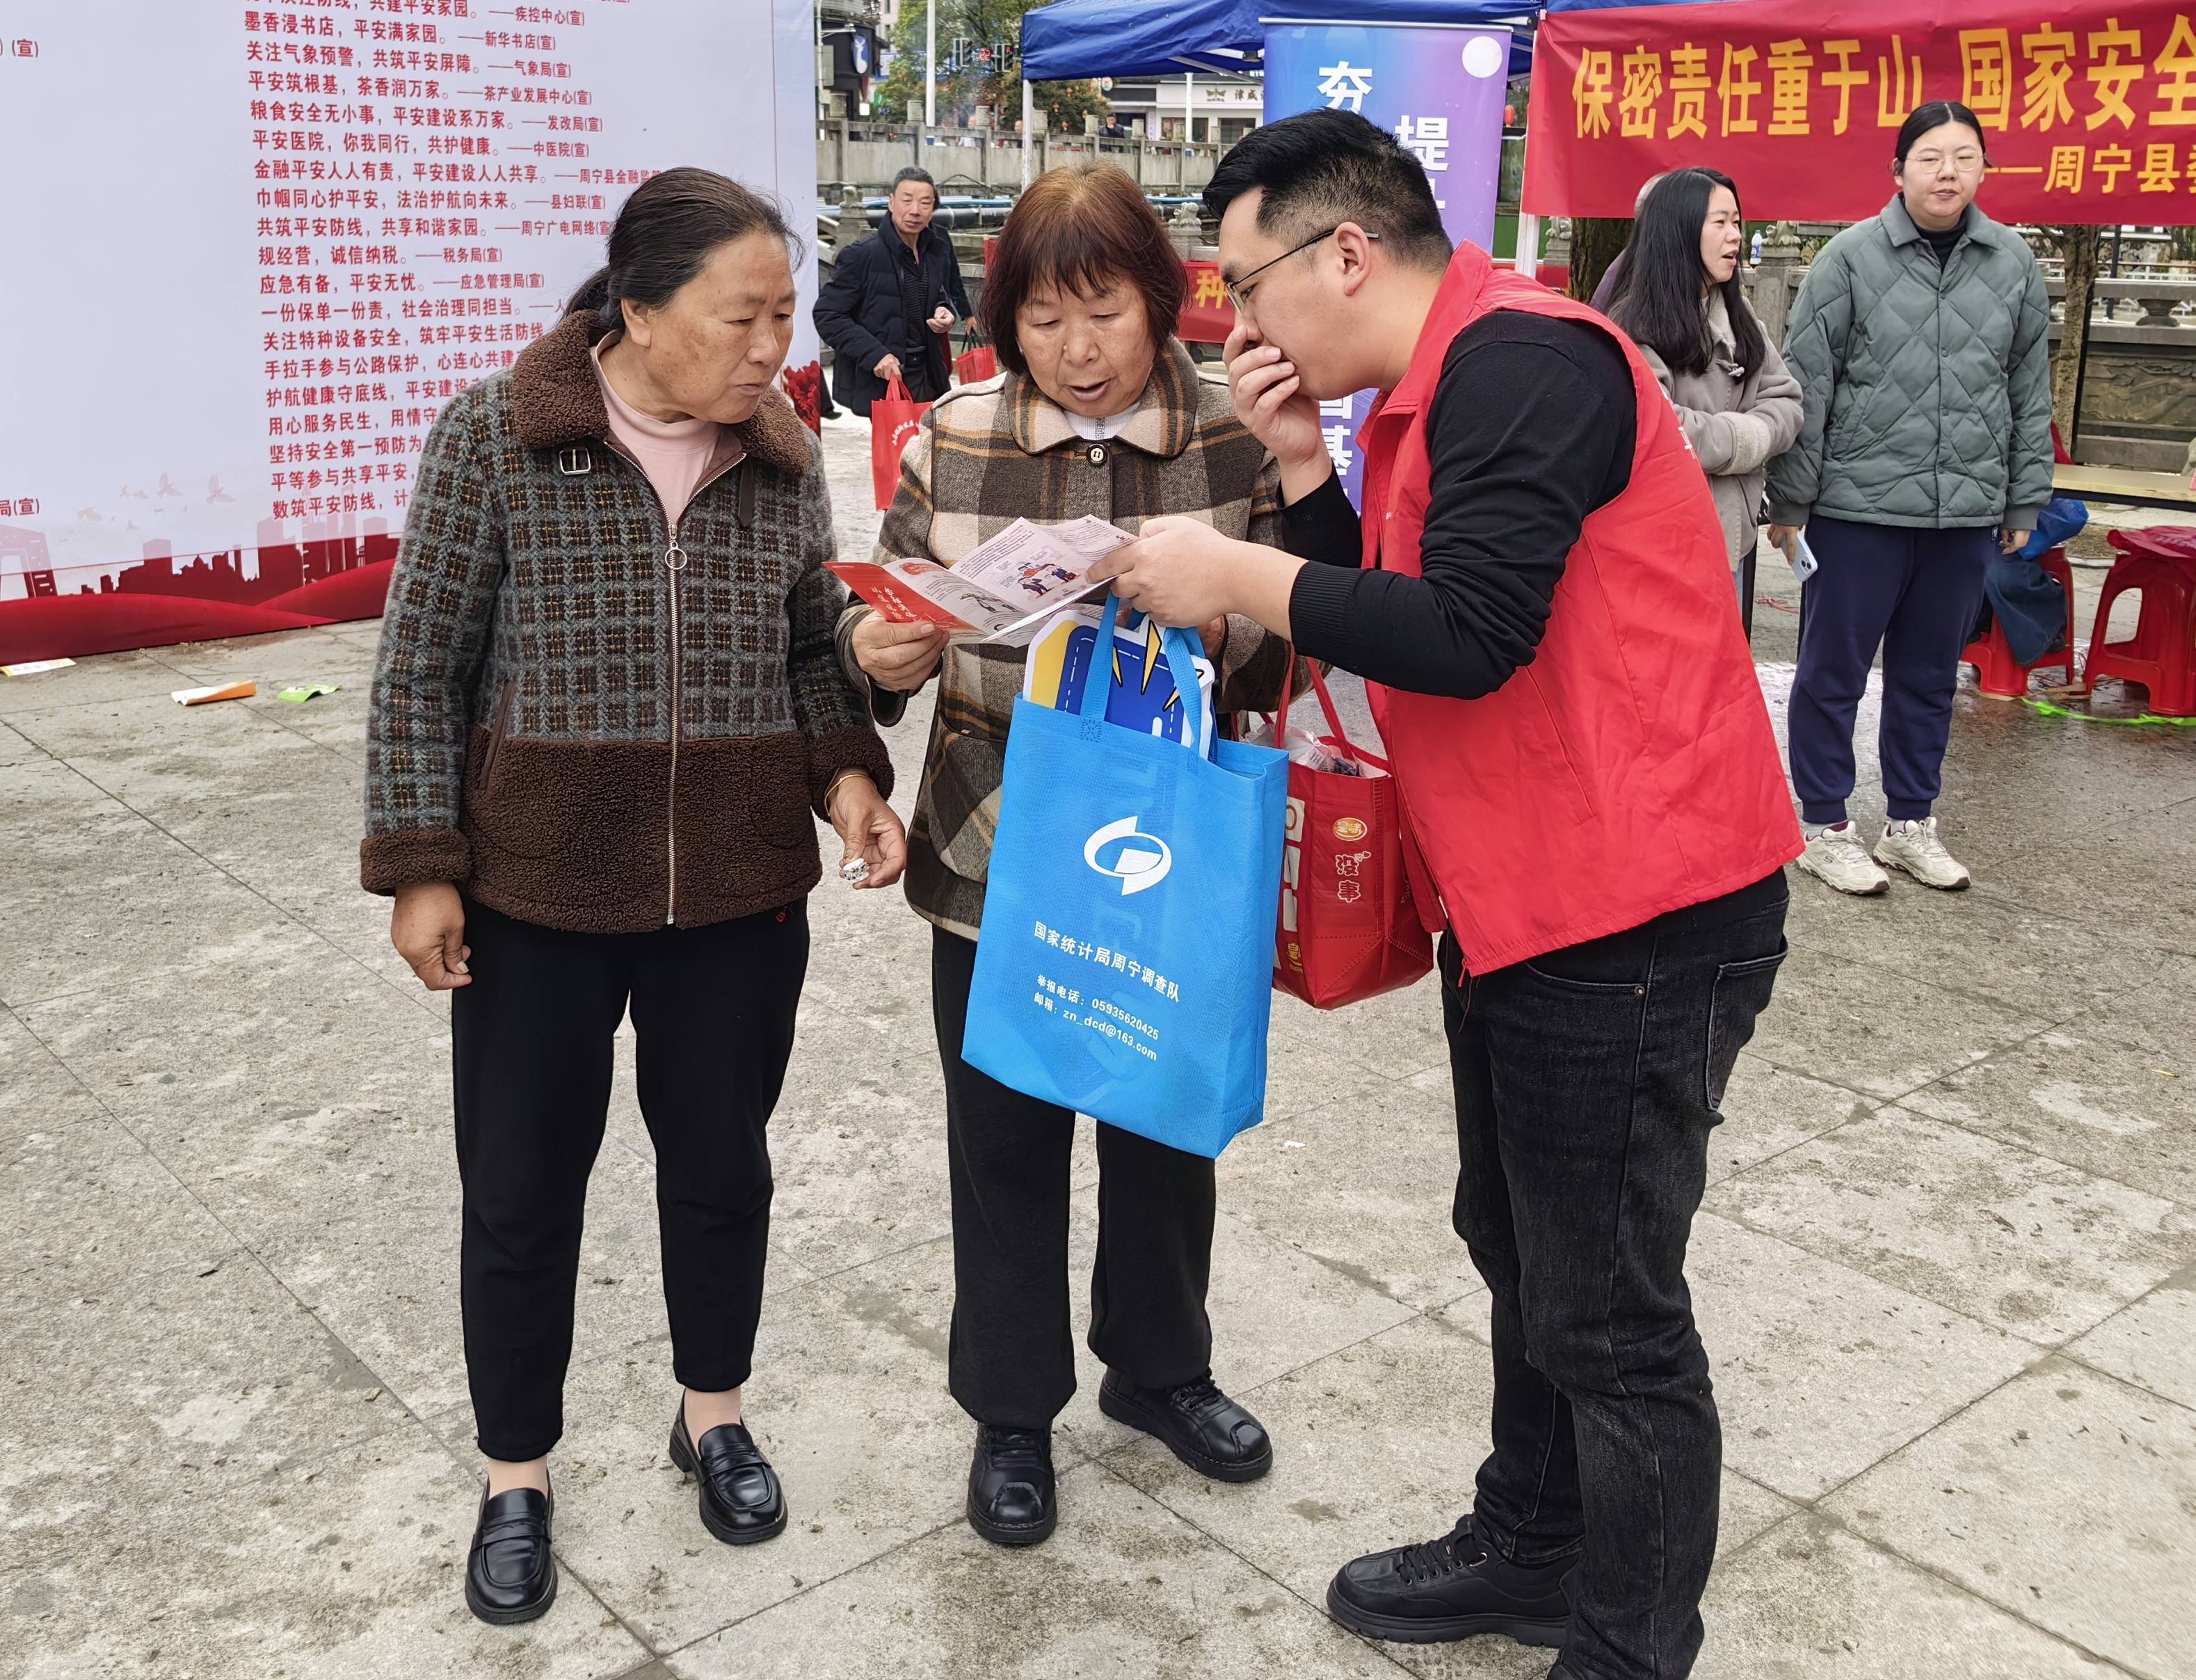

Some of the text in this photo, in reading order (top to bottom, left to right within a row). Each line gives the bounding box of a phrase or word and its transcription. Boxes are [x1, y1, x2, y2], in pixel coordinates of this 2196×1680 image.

[1572, 14, 2196, 139] 保密责任重于山 国家安全
[264, 350, 524, 380] 手拉手参与公路保护，心连心共建
[266, 376, 479, 408] 护航健康守底线，平安建设
[1034, 920, 1180, 1003] 国家统计局周宁调查队
